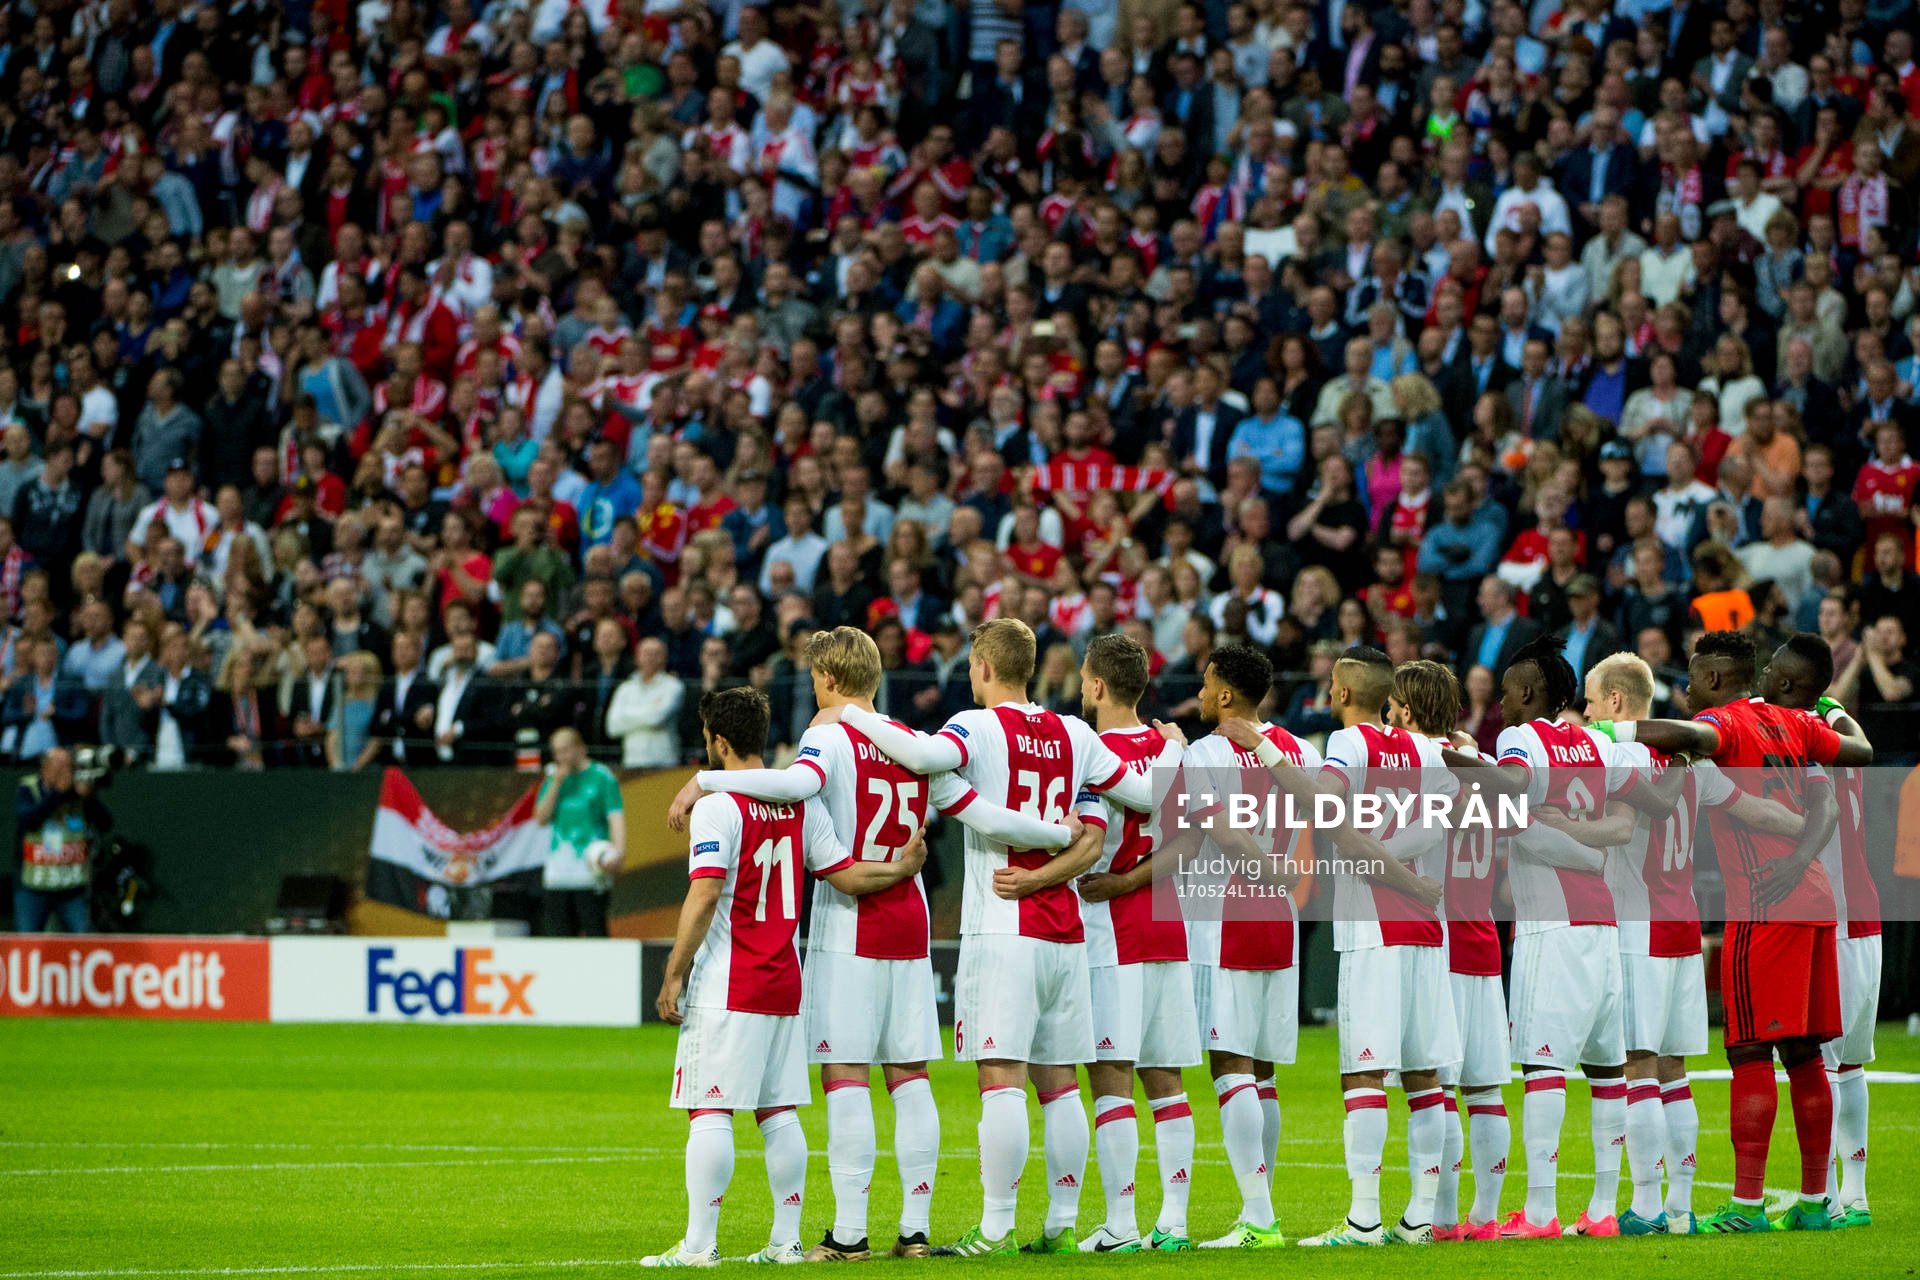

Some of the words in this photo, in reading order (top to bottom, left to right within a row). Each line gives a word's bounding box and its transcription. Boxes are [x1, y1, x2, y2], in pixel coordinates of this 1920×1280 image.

[861, 778, 919, 862] 25
[1451, 810, 1493, 880] 20
[753, 836, 796, 922] 11
[8, 949, 225, 1010] UniCredit
[367, 947, 536, 1016] FedEx
